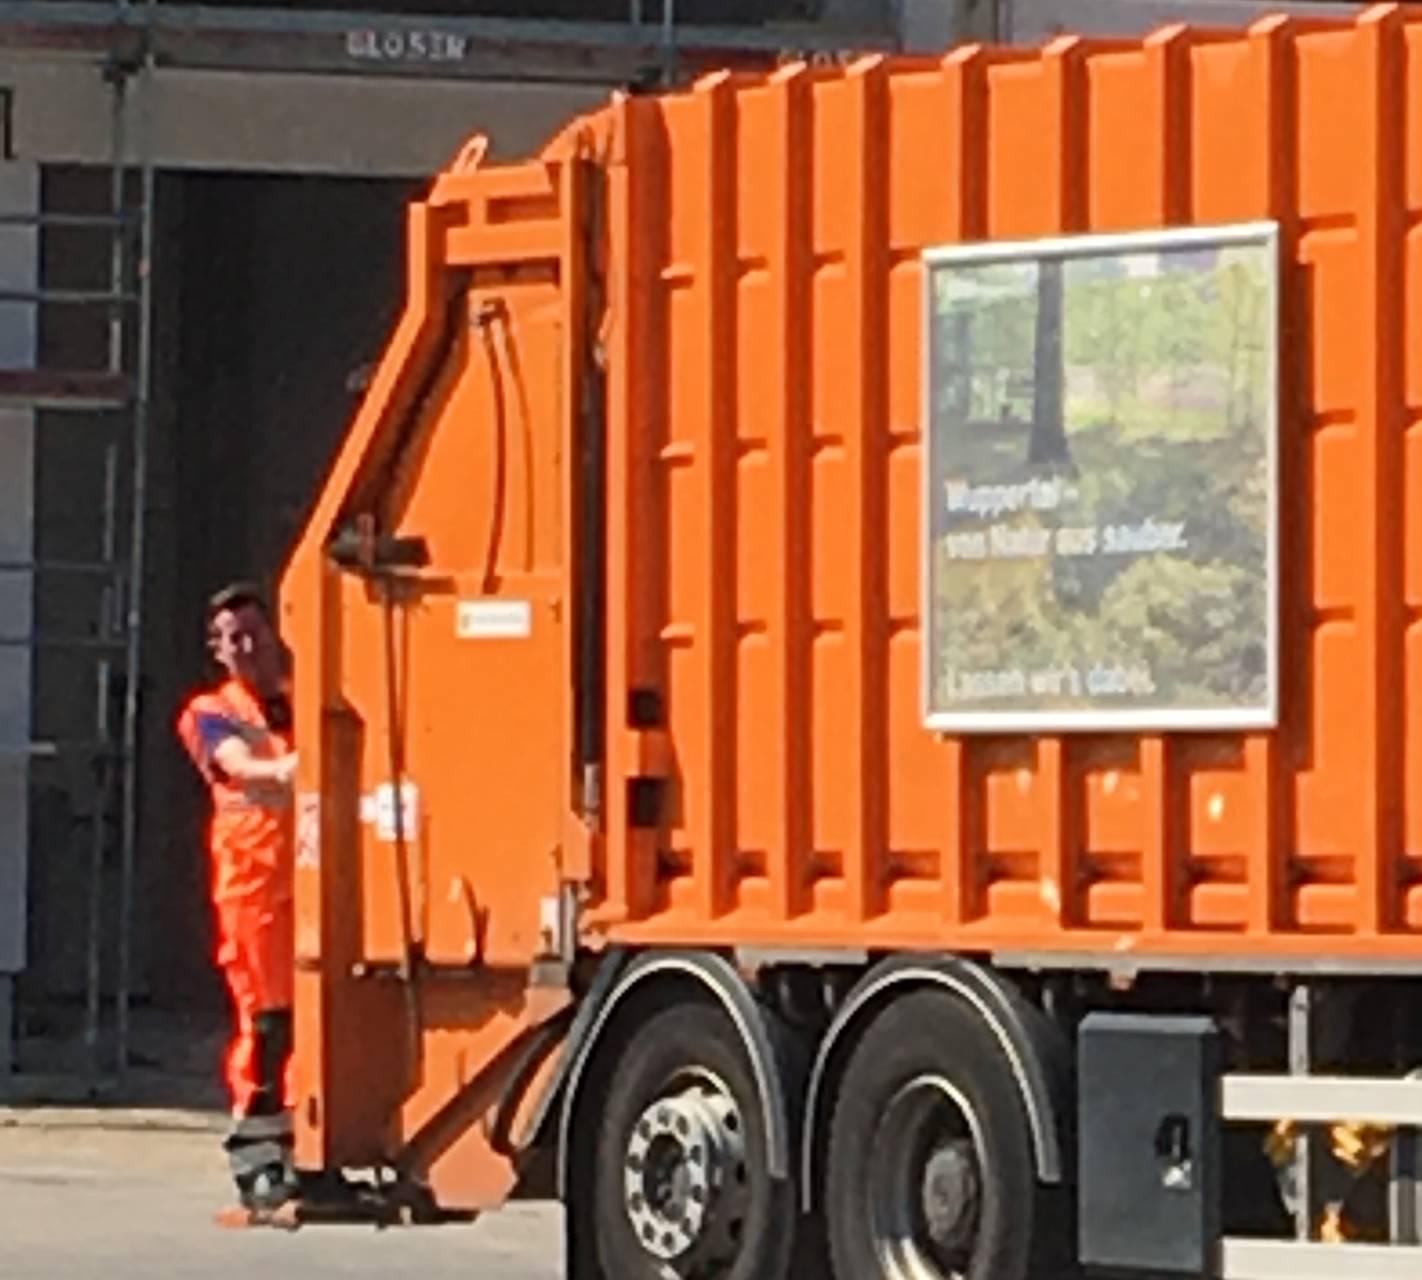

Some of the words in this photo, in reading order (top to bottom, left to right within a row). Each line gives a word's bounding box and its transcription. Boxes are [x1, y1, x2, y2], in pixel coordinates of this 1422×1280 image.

[945, 475, 1061, 518] Wuppertal
[947, 531, 986, 559] von
[990, 523, 1051, 556] Natur
[1055, 527, 1098, 556] aus
